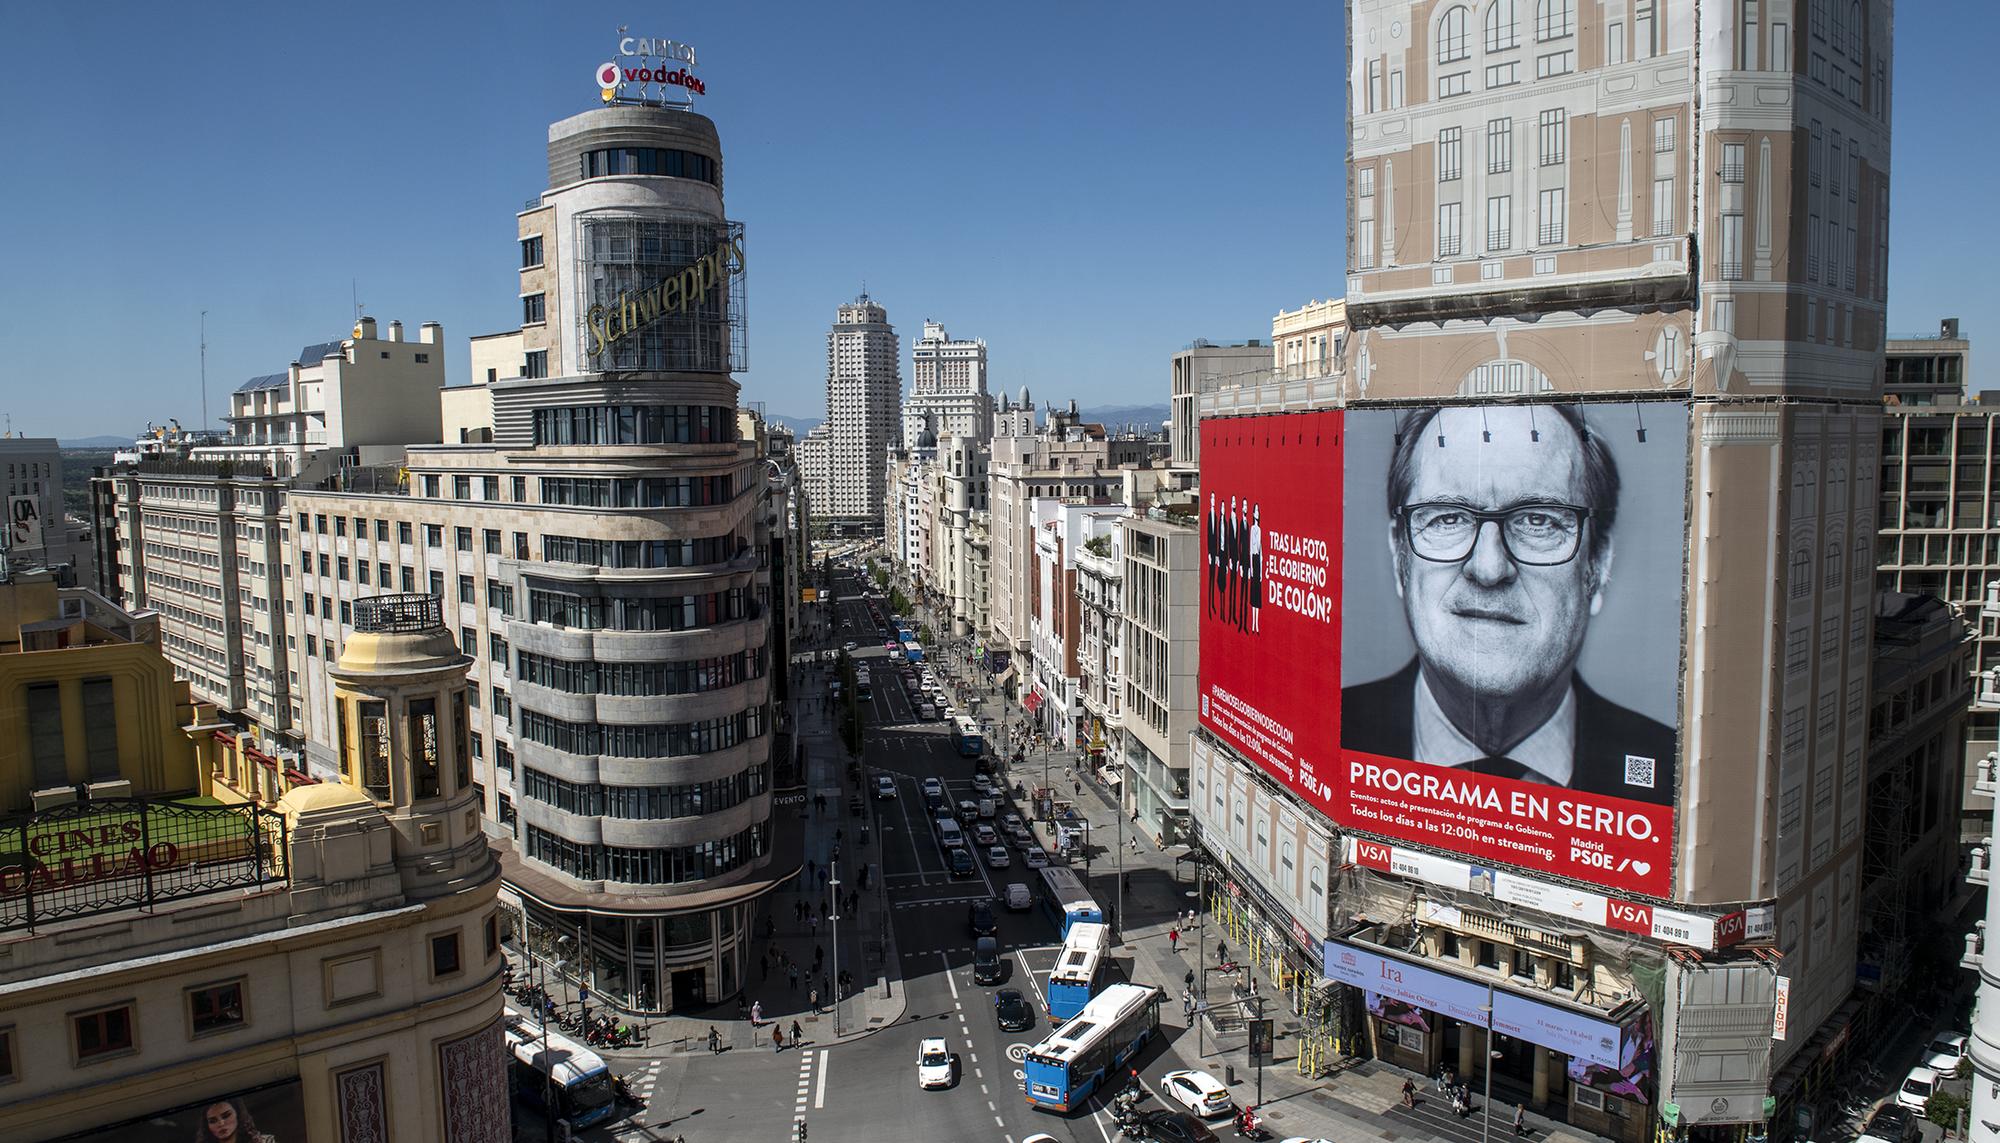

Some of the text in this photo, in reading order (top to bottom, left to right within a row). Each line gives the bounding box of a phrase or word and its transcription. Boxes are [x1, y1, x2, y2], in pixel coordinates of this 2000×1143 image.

[620, 37, 696, 65] CAPITOL
[624, 64, 706, 96] vodafone
[586, 232, 746, 358] Schweppes
[1269, 530, 1330, 567] TRAS LA FOTO,
[1265, 554, 1327, 588] ¿EL GOBIERNO
[1268, 580, 1332, 624] DE COLÓN?
[1300, 757, 1314, 774] Madrid
[1299, 768, 1318, 794] PSOE
[774, 794, 806, 806] EVENTO
[1350, 761, 1660, 843] PROGRAMA EN SERIO.
[1350, 790, 1555, 840] Eventos: actos de presentación de programa de Gobierno.
[30, 820, 141, 856] CINES
[1350, 803, 1556, 862] Todos los días a las 12:00h en streaming.
[1570, 836, 1605, 852] Madrid
[0, 841, 178, 894] CALLAO
[1359, 843, 1389, 864] VSA
[1570, 847, 1614, 871] PSOE
[1610, 903, 1650, 926] VSA
[1719, 916, 1744, 936] VSA
[1662, 925, 1674, 937] 404
[1380, 959, 1403, 984] Ira
[1396, 987, 1416, 1001] Julián
[1415, 993, 1438, 1008] Ortega
[1447, 1004, 1477, 1020] Dirección
[1492, 1017, 1521, 1034] Jemmett
